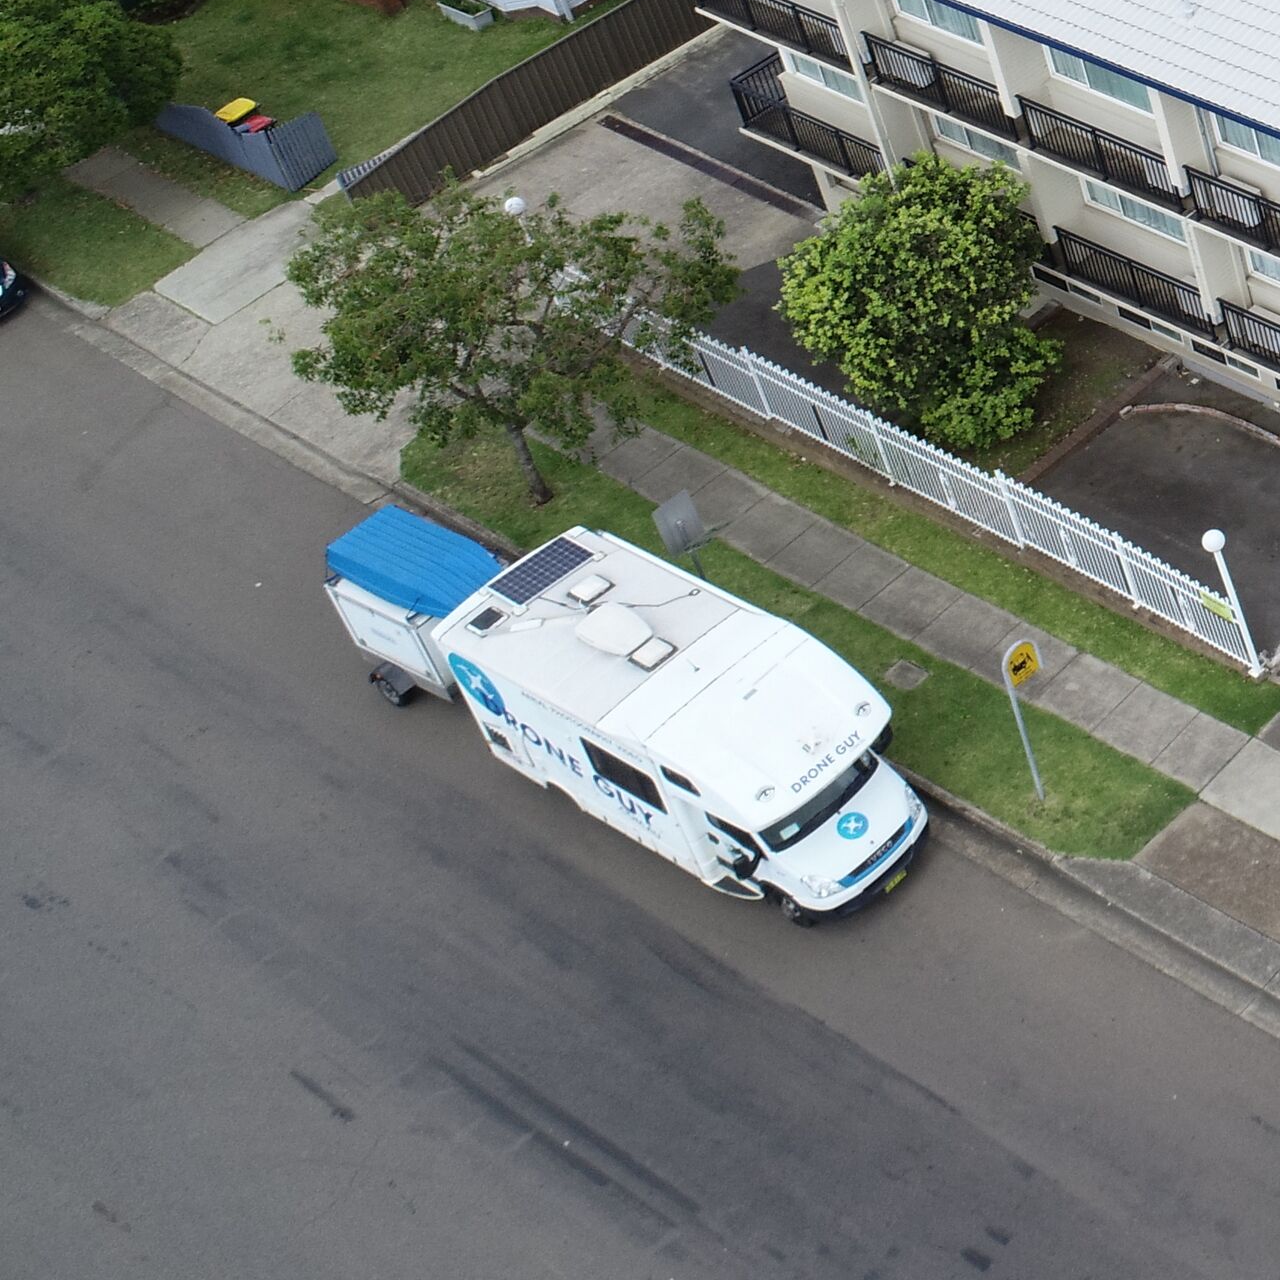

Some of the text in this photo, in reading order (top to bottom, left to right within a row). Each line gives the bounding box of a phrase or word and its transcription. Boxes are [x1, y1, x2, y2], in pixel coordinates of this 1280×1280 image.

[477, 688, 584, 778] DRONE
[592, 774, 653, 825] GUY
[791, 751, 836, 794] DRONE
[835, 730, 861, 756] GUY
